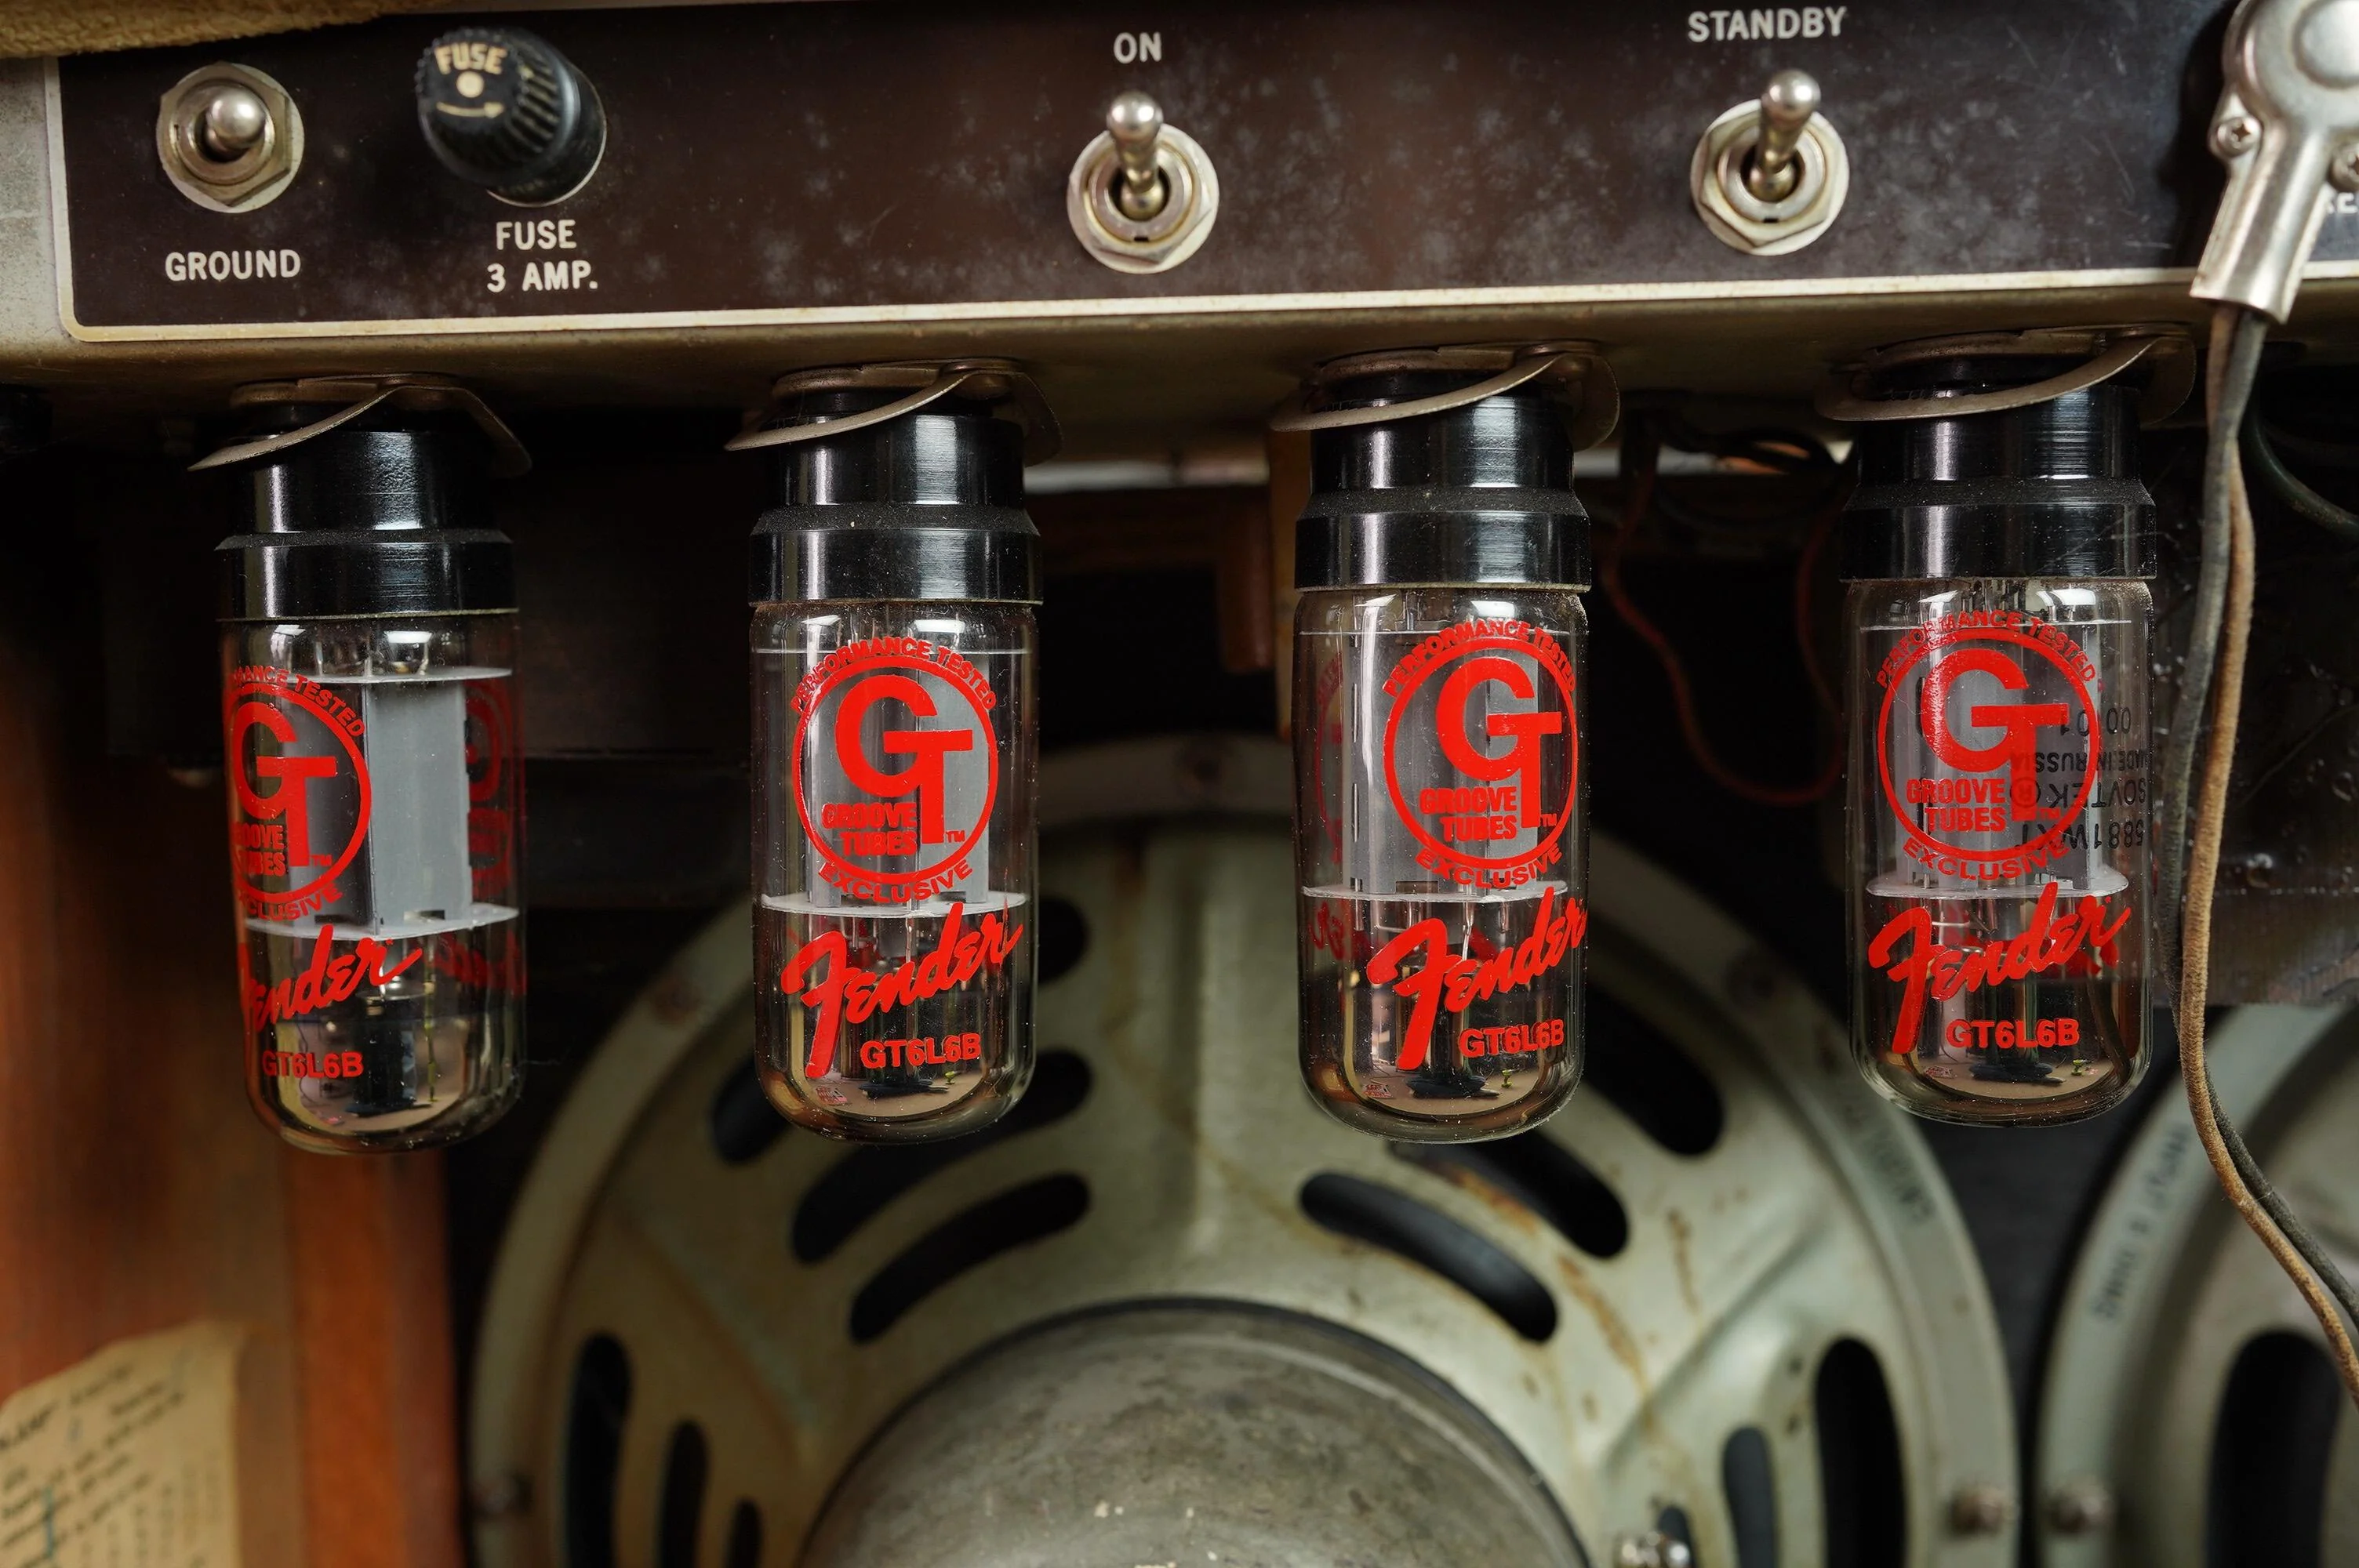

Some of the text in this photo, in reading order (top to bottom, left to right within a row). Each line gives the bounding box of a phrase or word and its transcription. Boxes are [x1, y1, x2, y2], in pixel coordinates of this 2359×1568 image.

[1688, 6, 1847, 42] STANDBY
[434, 42, 507, 75] FUSE
[1114, 32, 1161, 64] ON
[496, 220, 577, 250] FUSE
[165, 249, 301, 281] GROUND
[487, 260, 598, 292] 3 AMP.
[1383, 618, 1530, 697] PERFORMANCE
[1534, 626, 1576, 691] TESTED
[1876, 609, 2096, 688] PERFORMANCE TESTED
[791, 636, 996, 715] PERFORMANCE TESTED
[294, 673, 365, 737] TESTED
[1436, 657, 1561, 829] GT
[1921, 648, 2069, 822] GT
[835, 674, 972, 843] GT
[233, 702, 337, 867] GT
[1419, 786, 1517, 815] GROOVE
[1906, 779, 2005, 804] GROOVE
[822, 802, 917, 829] GROOVE
[1440, 815, 1517, 841] TUBES
[1925, 807, 2007, 833] TUBES
[839, 830, 918, 856] TUBES
[1903, 837, 2070, 880] EXCLUSIVE
[818, 858, 972, 903] EXCLUSIVE
[1415, 843, 1563, 888] EXCLUSIVE
[1367, 887, 1587, 1070] Fender
[1868, 881, 2131, 1054] Fender
[780, 901, 1023, 1078] Fender
[860, 1032, 981, 1069] GT6L6B
[1459, 1018, 1565, 1058] GT6L6B
[1945, 1017, 2081, 1049] GT6L6B
[262, 1050, 364, 1079] GT6L6B
